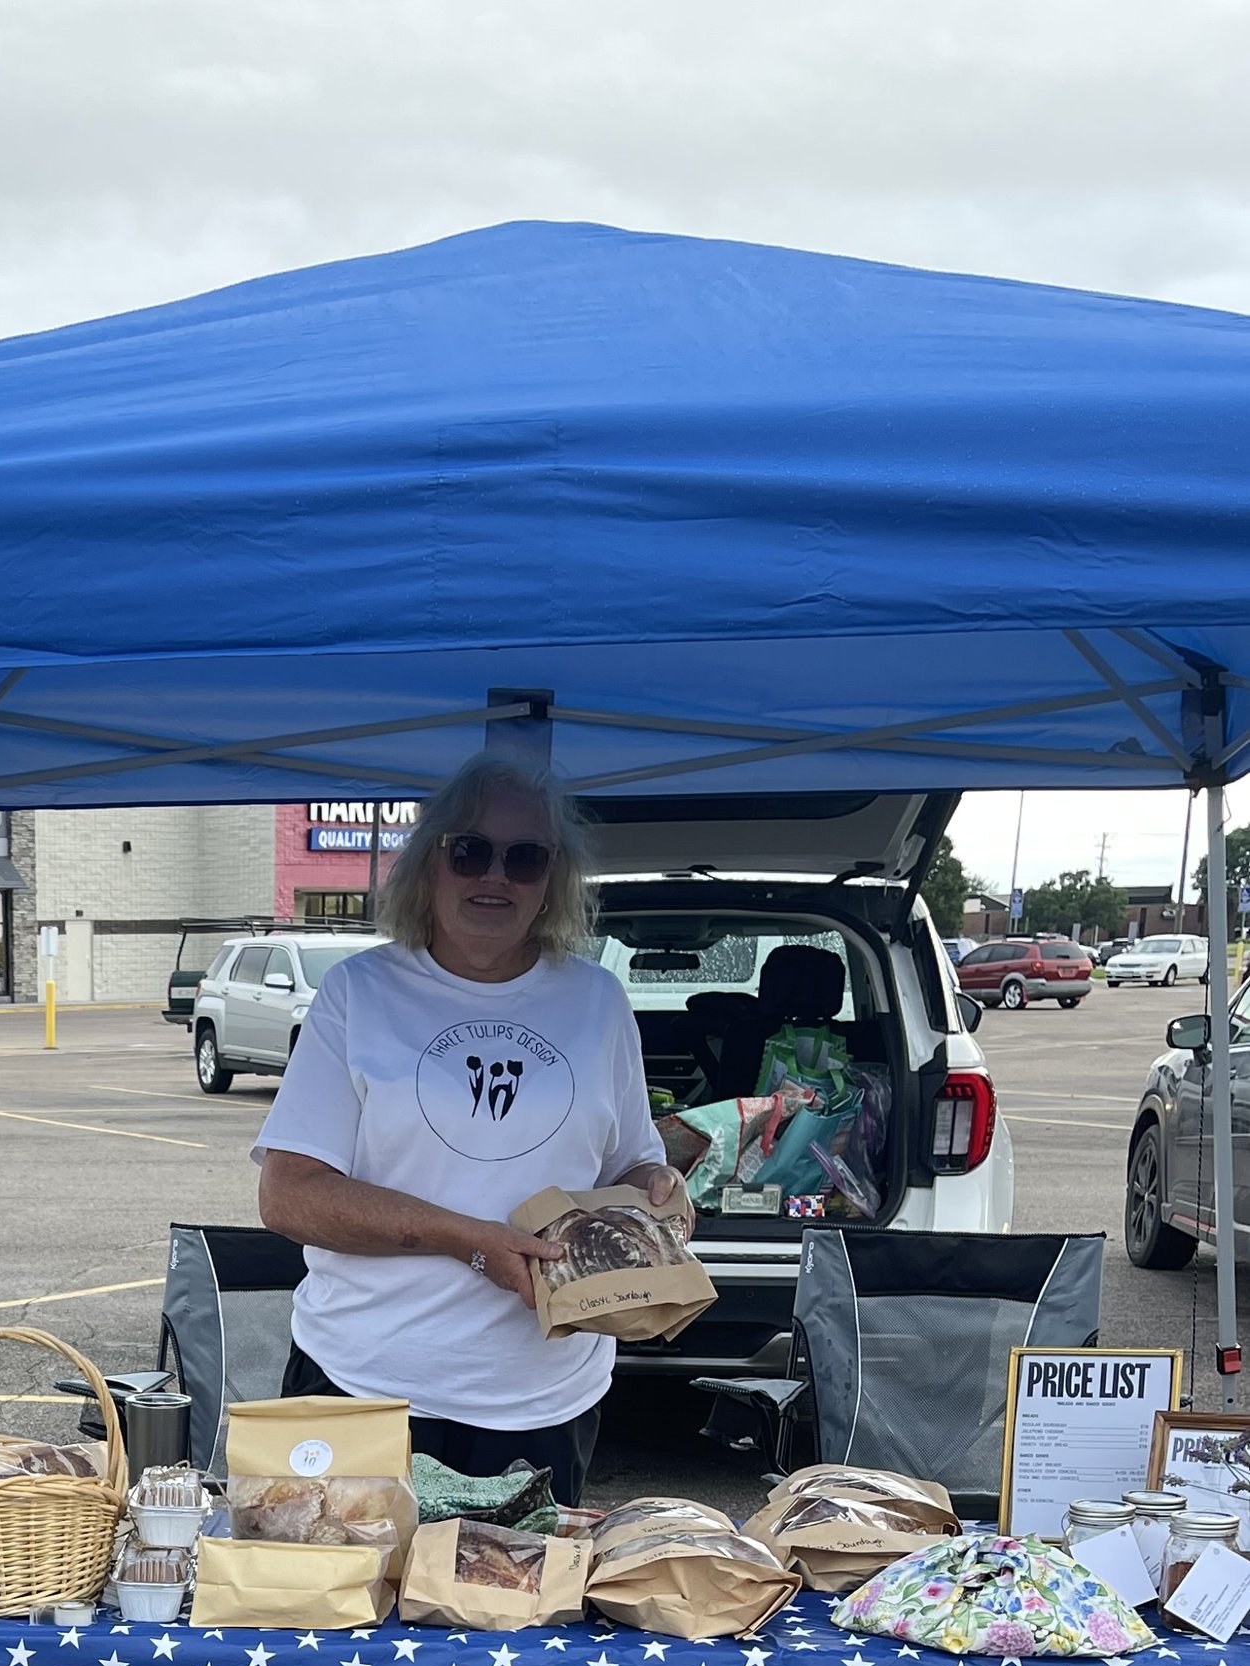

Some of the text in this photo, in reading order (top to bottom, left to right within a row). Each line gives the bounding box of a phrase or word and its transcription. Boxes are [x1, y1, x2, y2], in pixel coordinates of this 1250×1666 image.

[318, 831, 373, 848] QUALITY
[428, 1025, 560, 1067] THREE TULIPS DESIGN
[1026, 1362, 1152, 1399] PRICE LIST
